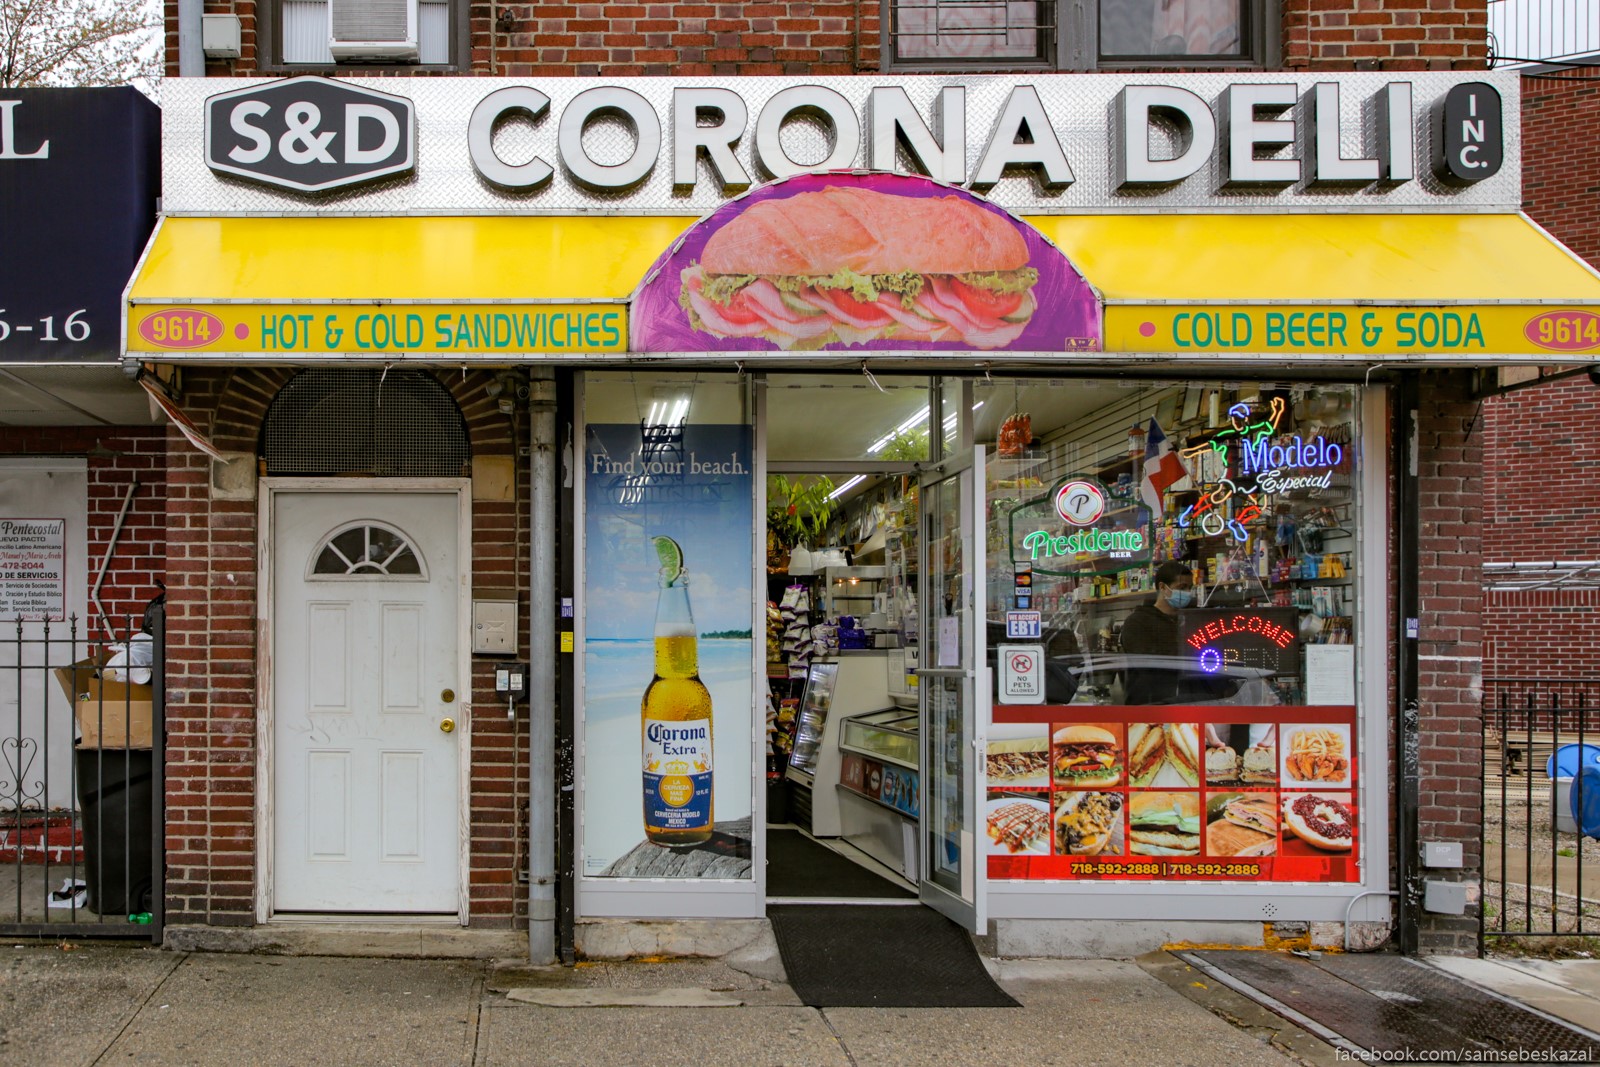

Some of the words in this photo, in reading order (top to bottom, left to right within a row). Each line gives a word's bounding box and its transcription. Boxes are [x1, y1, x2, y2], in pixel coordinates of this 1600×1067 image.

[228, 100, 400, 165] S&D
[467, 84, 1075, 190] CORONA
[1118, 81, 1414, 188] DELI
[152, 315, 210, 342] 9614
[261, 314, 313, 350] HOT
[324, 315, 344, 347] &
[354, 314, 424, 349] COLD
[434, 312, 620, 349] SANDWICHES
[1172, 312, 1252, 347] COLD
[1265, 312, 1348, 347] BEER
[1361, 312, 1383, 347] &
[1396, 312, 1485, 347] SODA
[1539, 317, 1600, 343] 9614
[591, 452, 636, 475] Find
[640, 461, 685, 478] your
[690, 451, 749, 475] beach.
[1241, 435, 1342, 474] Modelo
[1256, 469, 1333, 494] Especial
[1, 521, 62, 535] Pentecostal
[1022, 527, 1143, 561] Presidente
[1109, 551, 1132, 559] BEER
[1016, 587, 1031, 595] VISA
[1010, 621, 1037, 636] EBT
[1187, 615, 1295, 650] WELCOME
[1200, 648, 1280, 672] OPEN
[647, 723, 706, 746] Corona
[663, 742, 697, 755] Extra
[1071, 863, 1159, 875] 718-592-2888
[1170, 864, 1259, 876] 718-592-2886
